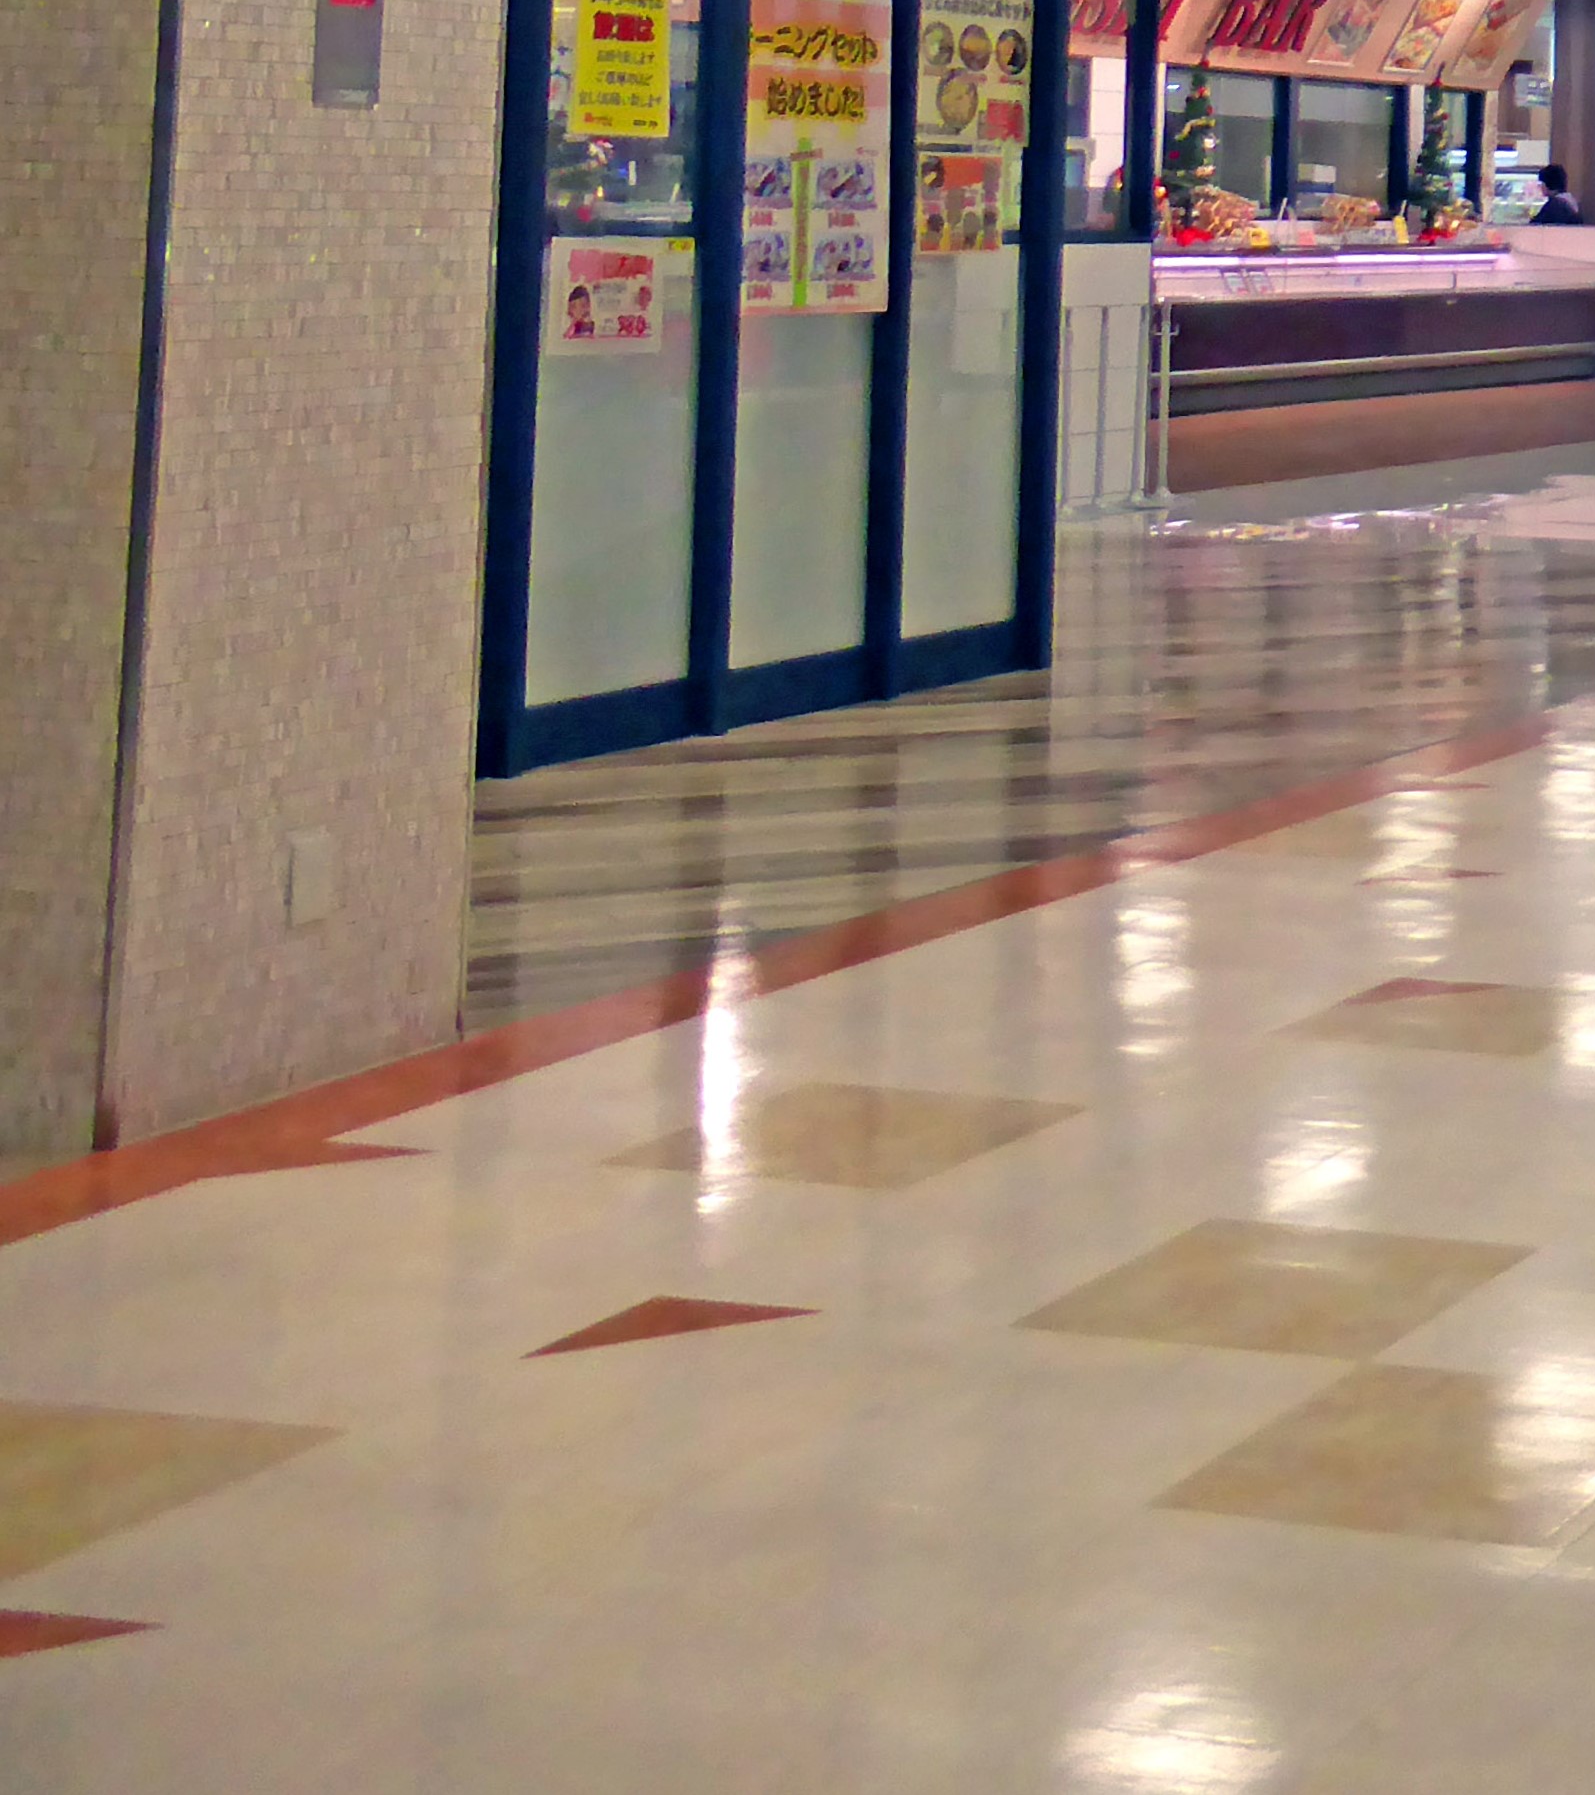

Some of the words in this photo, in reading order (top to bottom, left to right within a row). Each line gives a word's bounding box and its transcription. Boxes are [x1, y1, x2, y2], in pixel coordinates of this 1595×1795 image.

[749, 25, 879, 64] ーニングセット
[767, 78, 865, 117] 始めました!
